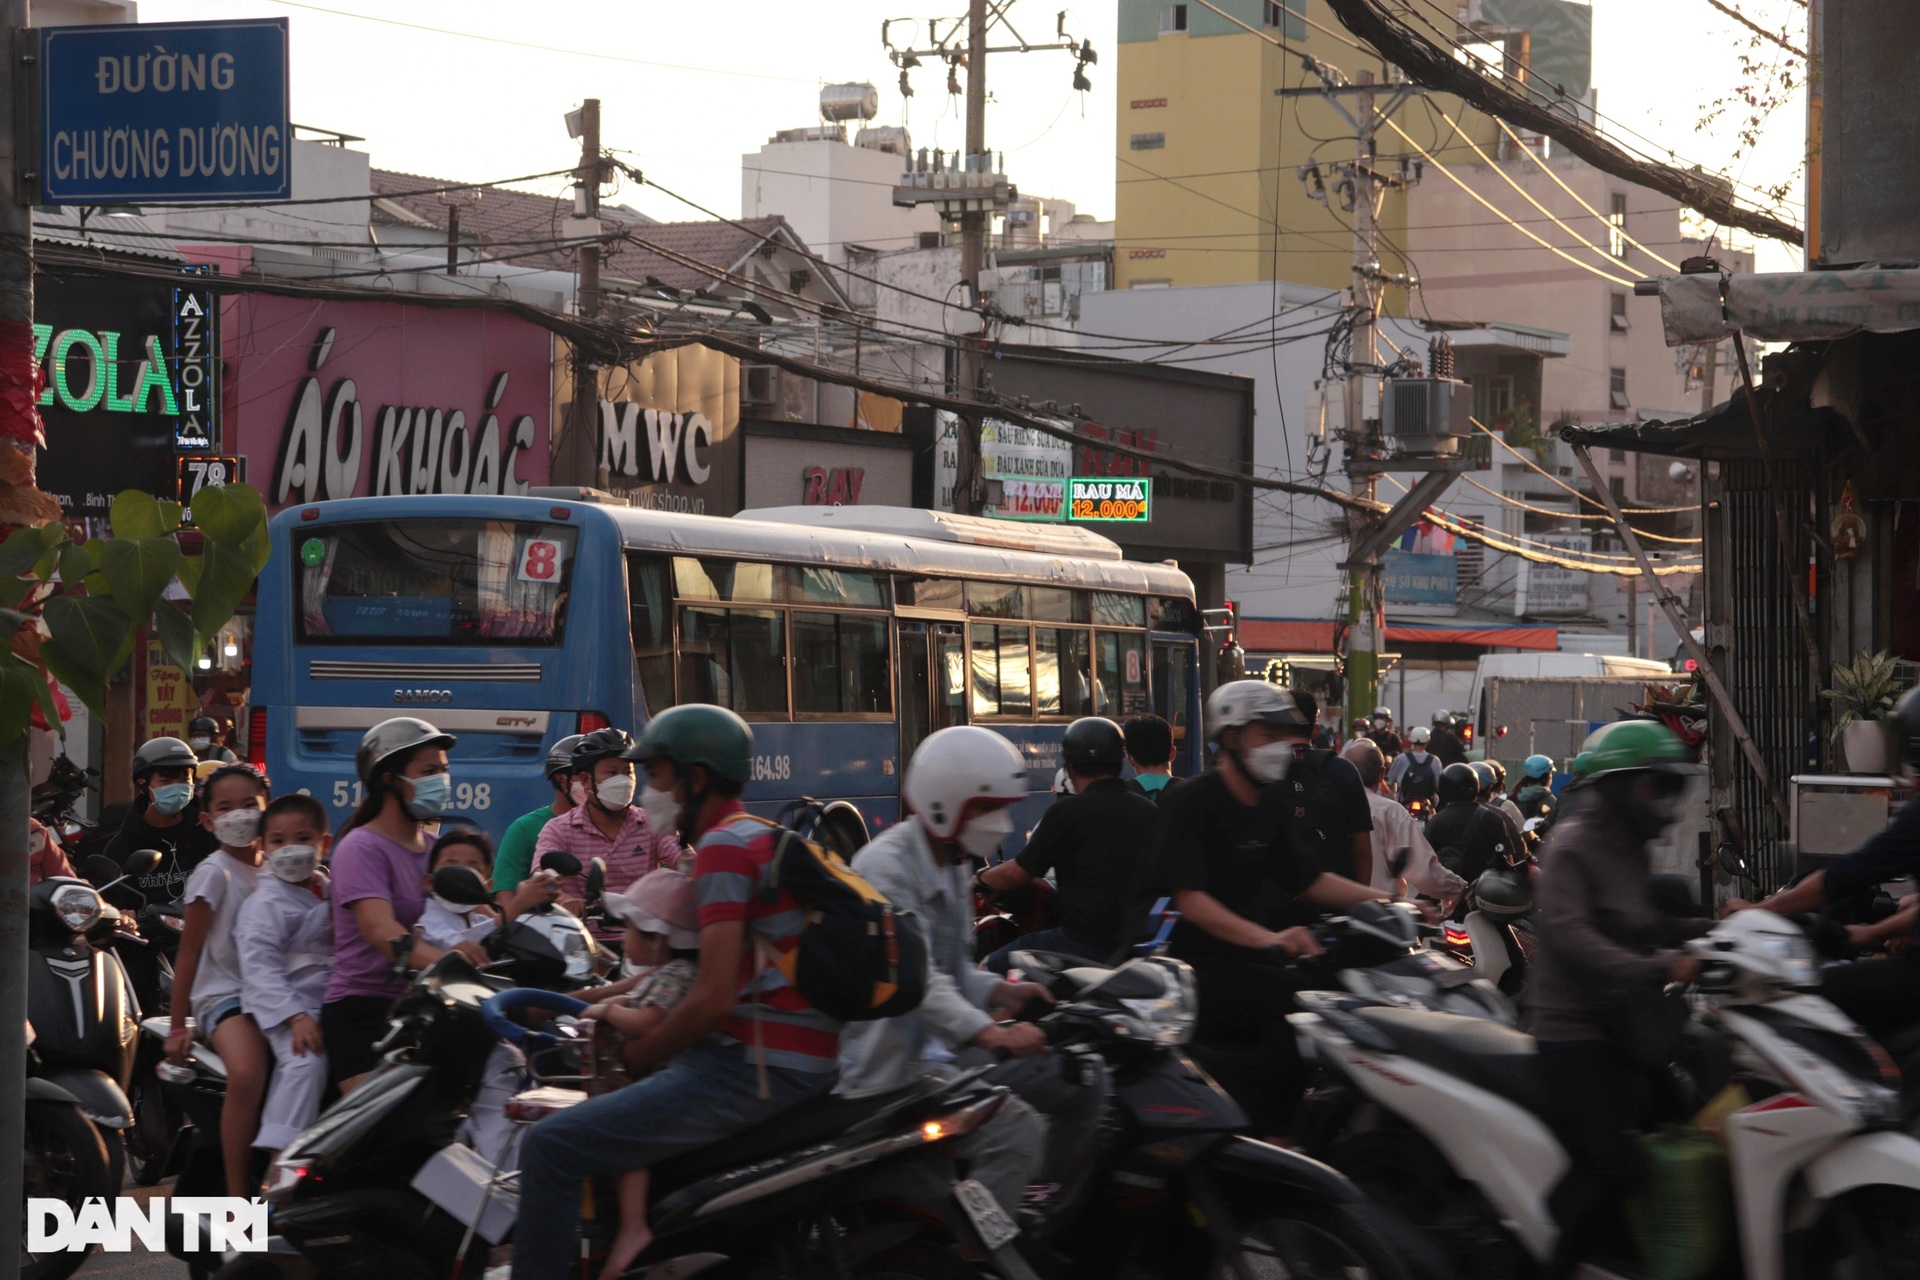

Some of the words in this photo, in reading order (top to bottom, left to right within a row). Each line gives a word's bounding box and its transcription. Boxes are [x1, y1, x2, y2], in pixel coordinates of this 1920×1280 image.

[95, 45, 235, 94] ĐƯỜNG
[53, 124, 170, 180] CHƯƠNG
[179, 121, 280, 178] DƯƠNG
[180, 293, 204, 435] AZZOLA
[273, 326, 362, 505] ÁO
[373, 371, 535, 497] KHOÁC
[599, 399, 712, 485] MWC
[188, 462, 226, 498] 78
[1014, 457, 1034, 475] XANH
[1073, 483, 1112, 499] RAU
[1115, 480, 1144, 500] MÁ
[525, 541, 557, 579] 8
[1129, 652, 1138, 680] 8
[156, 683, 175, 702] VÁY
[393, 689, 453, 703] SAMCO
[149, 703, 183, 724] CHỐNG
[496, 716, 537, 727] CITY
